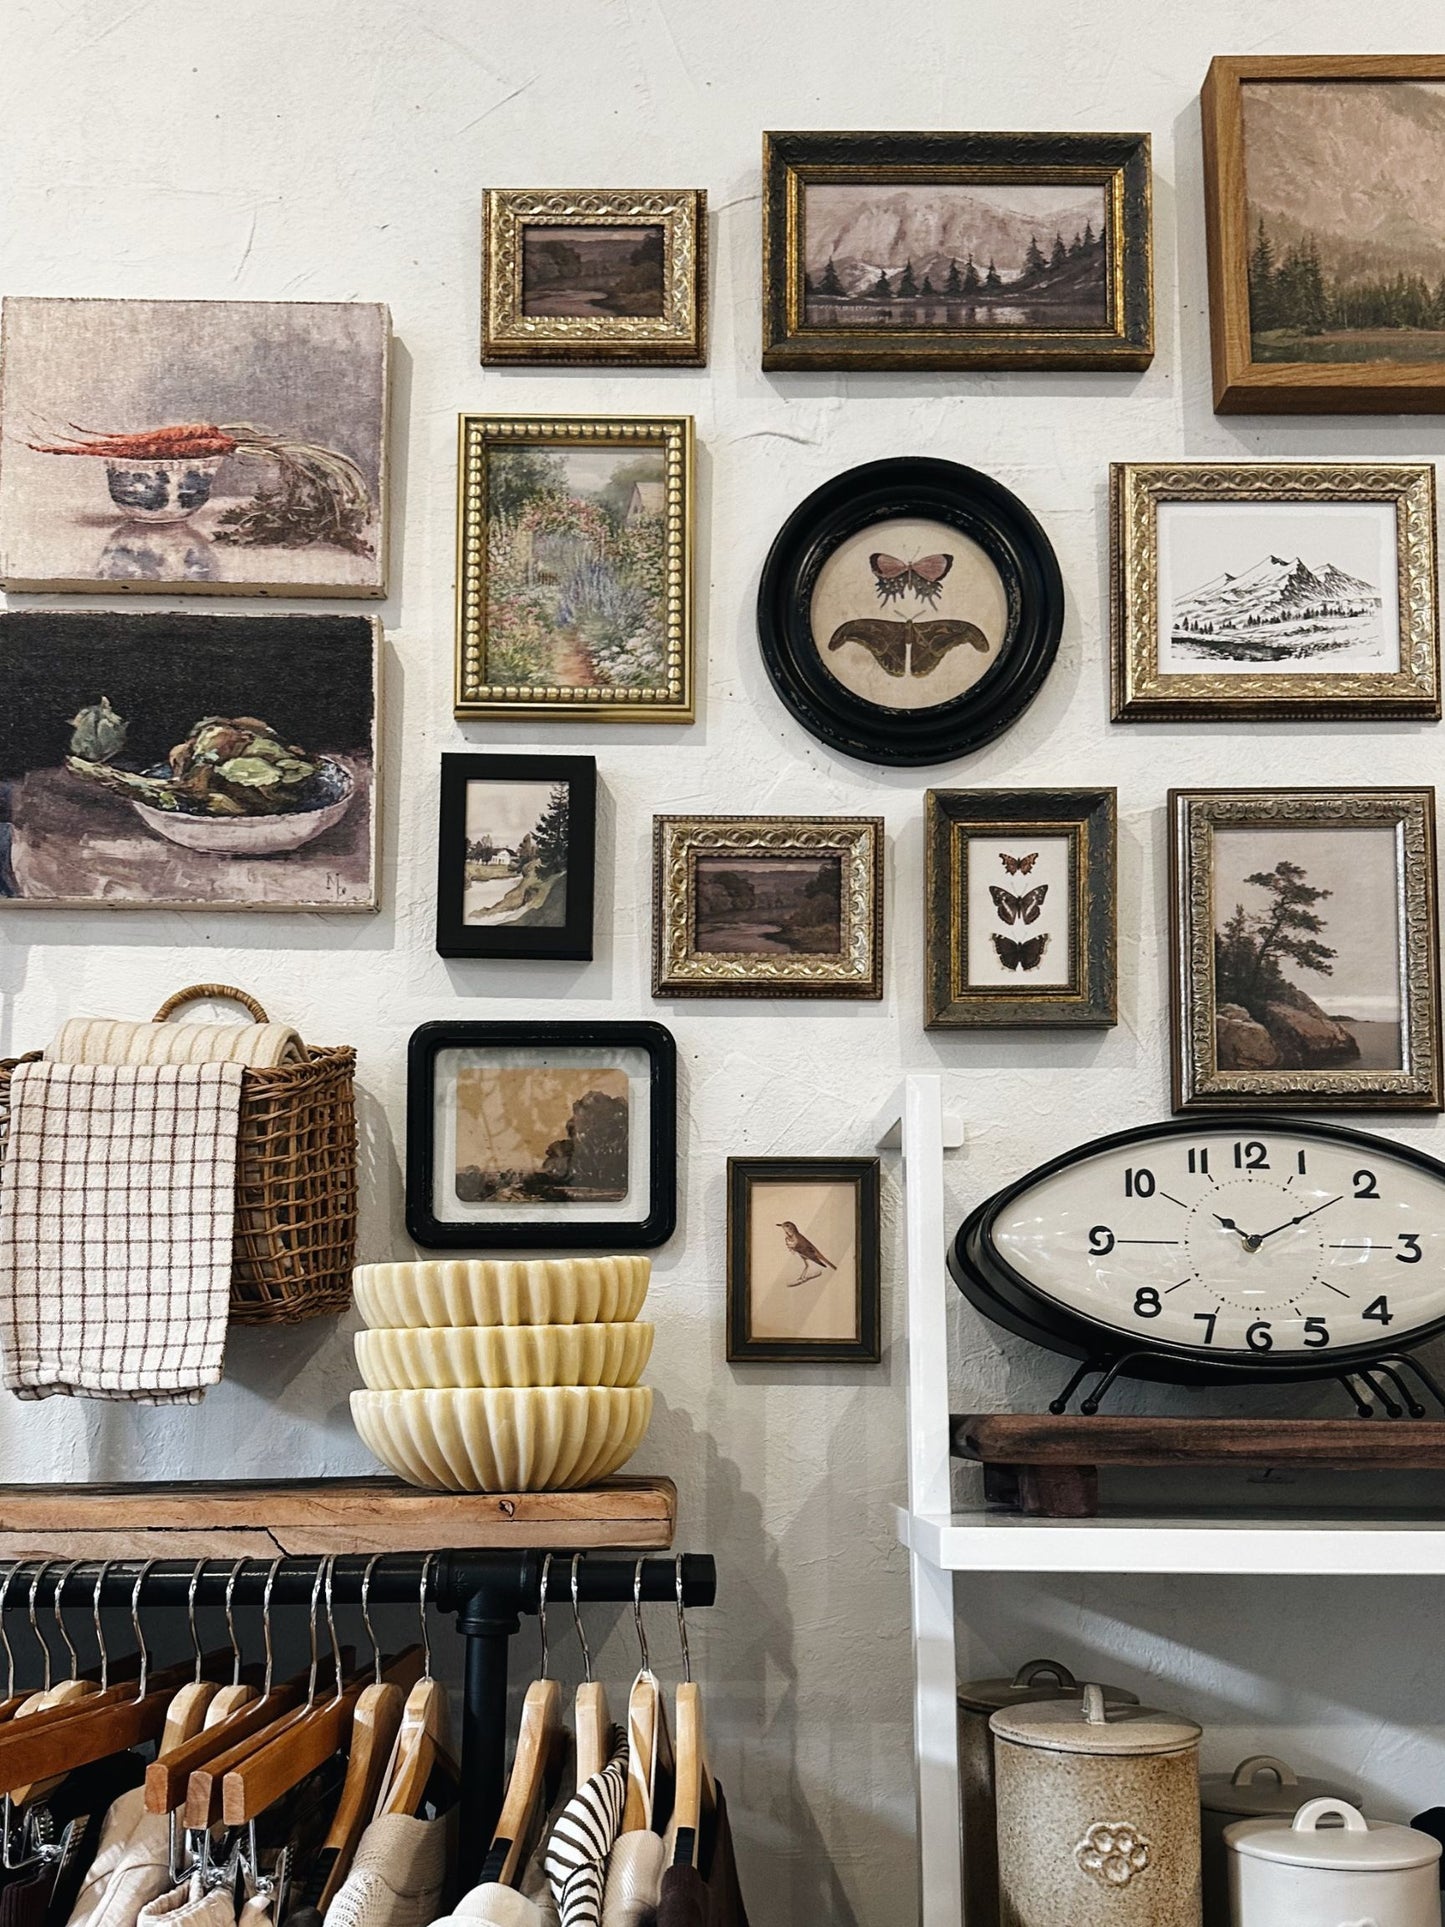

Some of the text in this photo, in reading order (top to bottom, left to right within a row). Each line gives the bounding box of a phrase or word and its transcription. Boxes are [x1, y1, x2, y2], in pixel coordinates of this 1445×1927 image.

[1188, 1148, 1208, 1174] 11
[1234, 1142, 1270, 1169] 12
[1298, 1149, 1306, 1174] 1
[1125, 1168, 1155, 1198] 10
[1353, 1169, 1380, 1199] 2
[1088, 1225, 1115, 1256] 9
[1395, 1233, 1422, 1264] 3
[1133, 1286, 1162, 1318] 8
[1362, 1296, 1393, 1326] 4
[1194, 1313, 1216, 1344] 7
[1246, 1321, 1273, 1350] 6
[1304, 1316, 1330, 1347] 5
